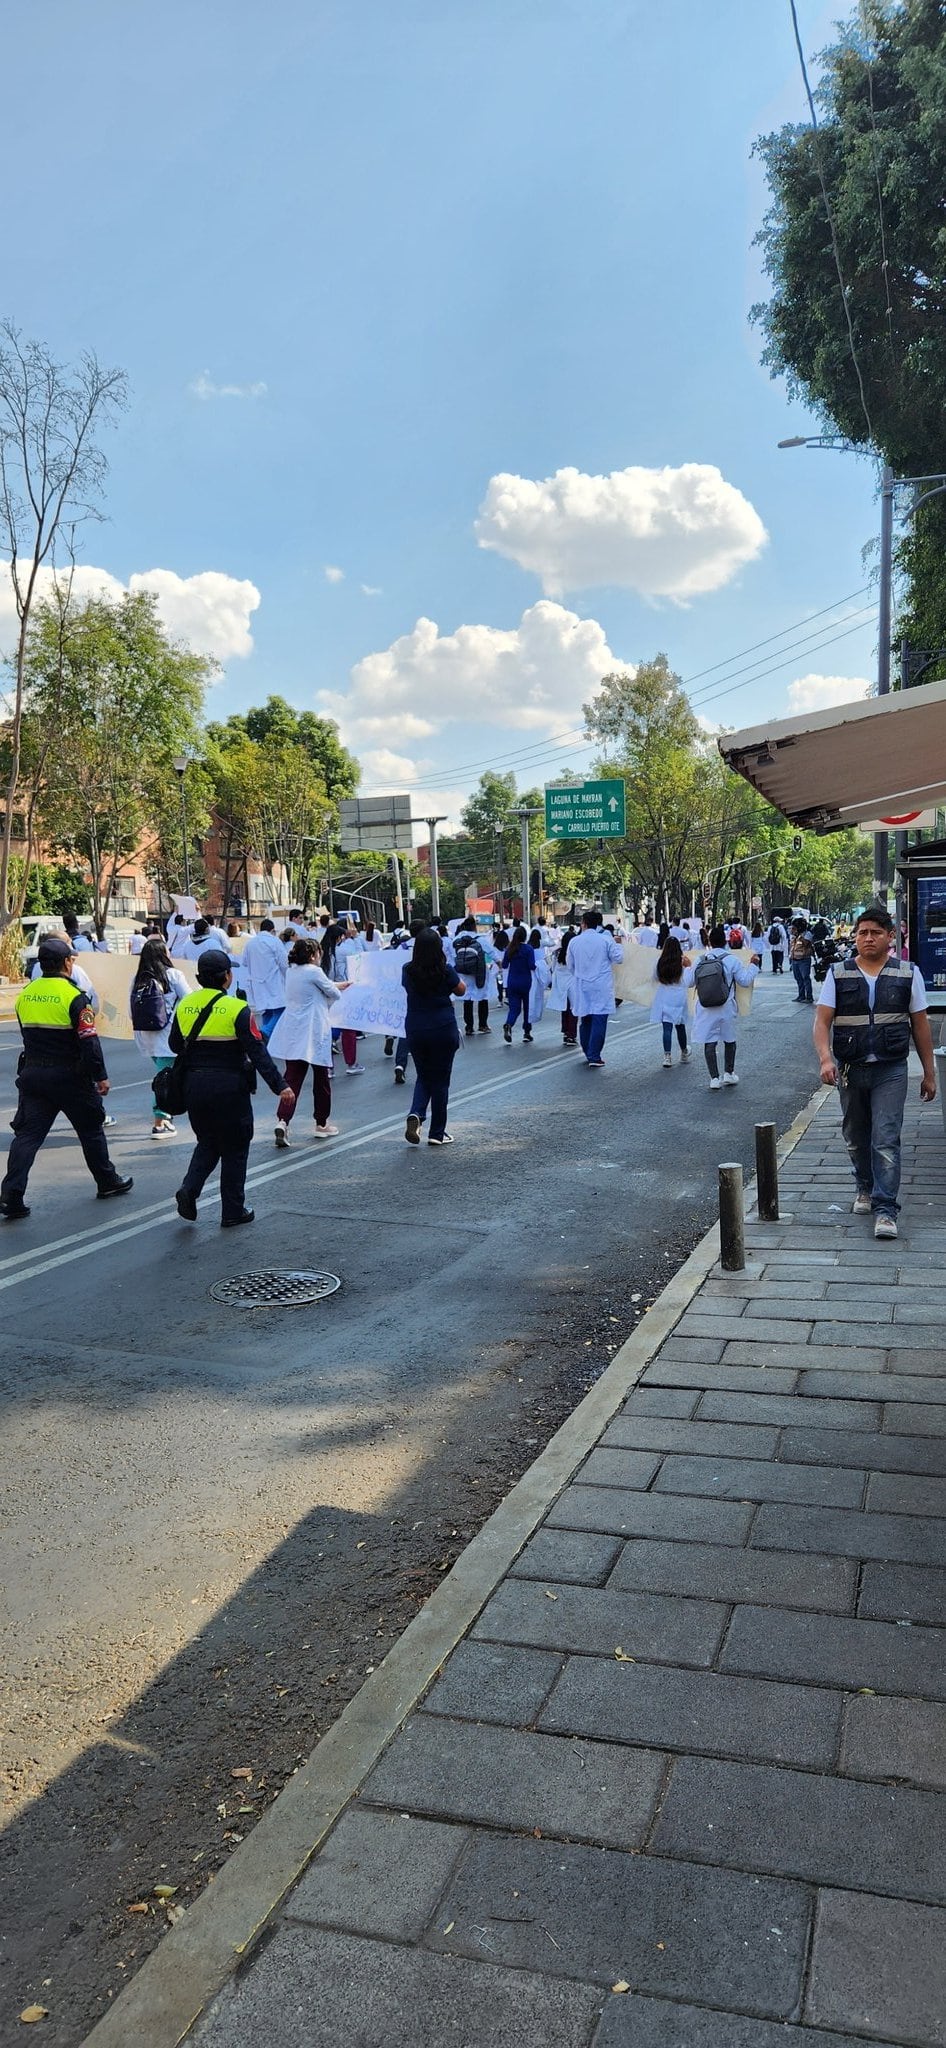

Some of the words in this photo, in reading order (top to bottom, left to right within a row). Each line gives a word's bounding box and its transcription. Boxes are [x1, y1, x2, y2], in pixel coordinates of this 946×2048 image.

[551, 795, 571, 804] LAGUNA
[573, 794, 580, 803] DE
[551, 810, 573, 819] MARIANO
[575, 809, 603, 819] ESCOBEDO
[568, 823, 590, 832] CARRILLO
[591, 822, 609, 832] PUERTO
[611, 822, 620, 831] OTE
